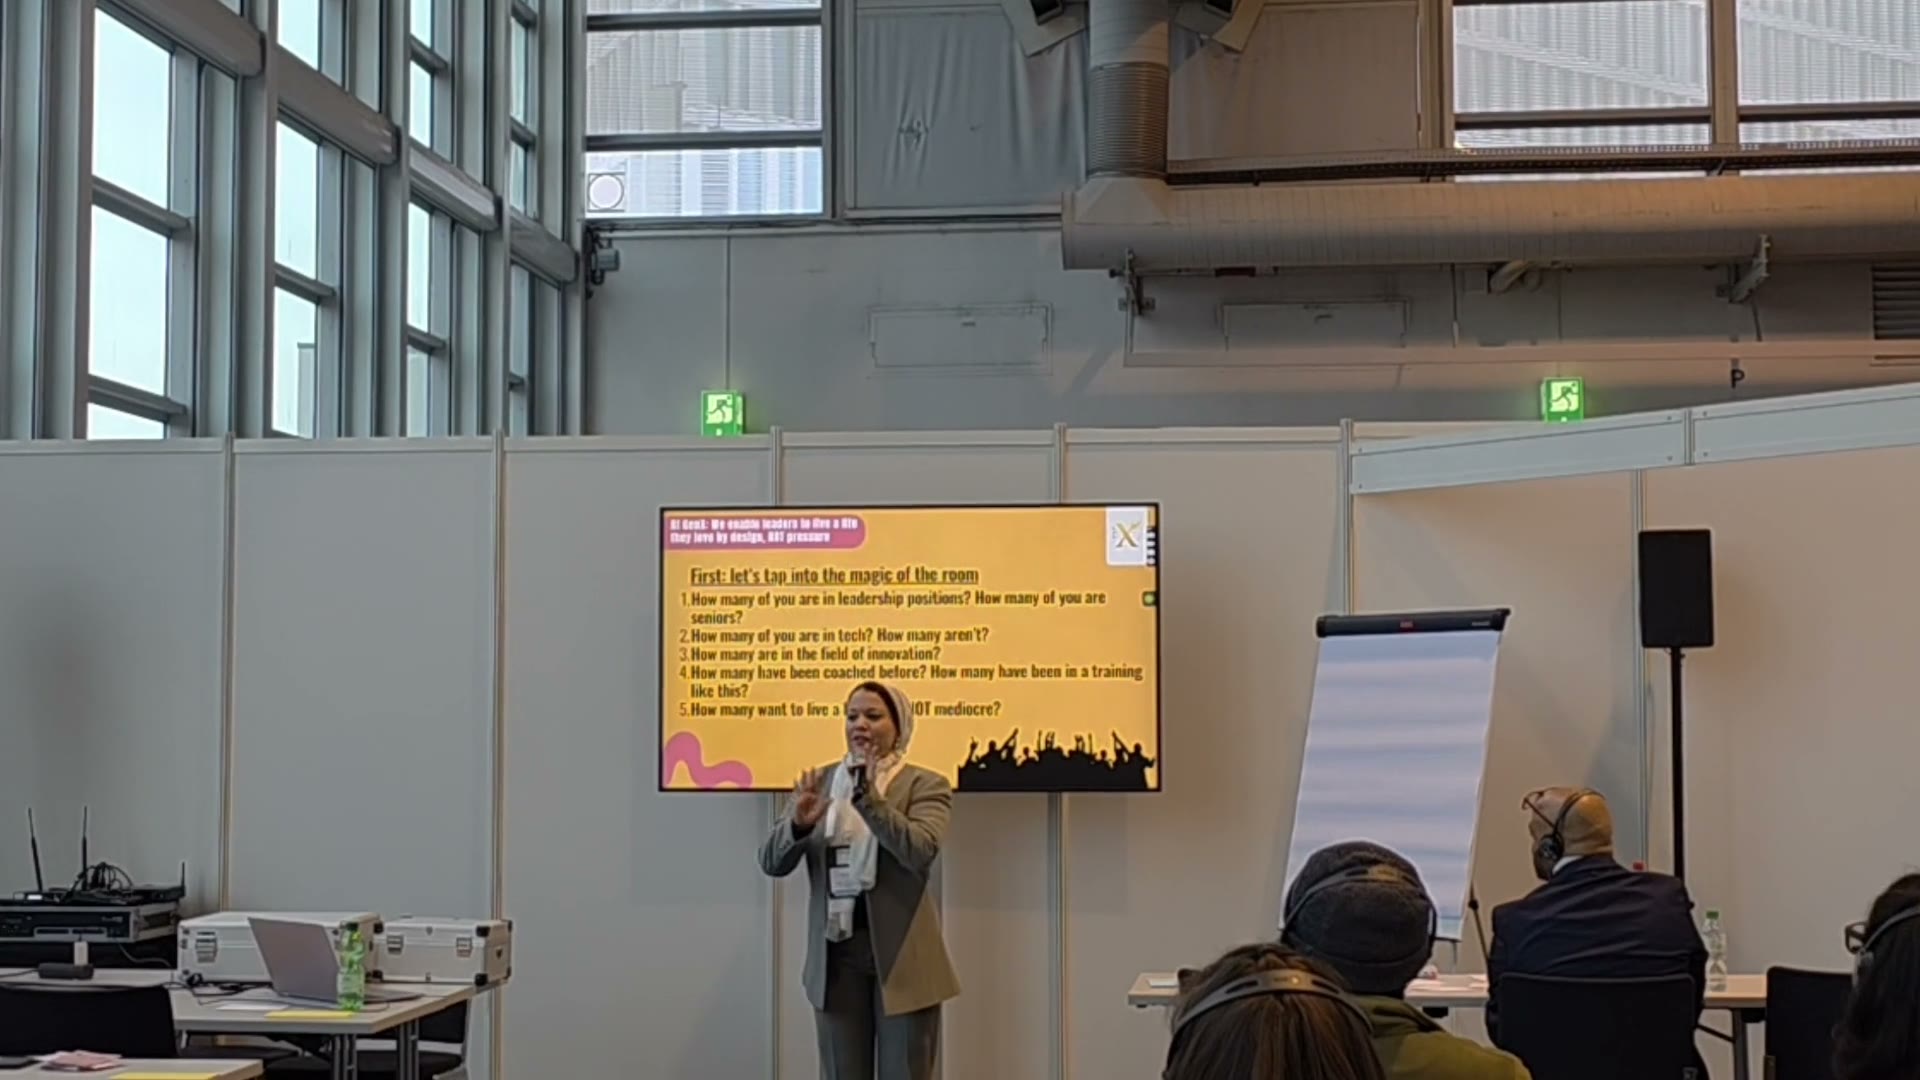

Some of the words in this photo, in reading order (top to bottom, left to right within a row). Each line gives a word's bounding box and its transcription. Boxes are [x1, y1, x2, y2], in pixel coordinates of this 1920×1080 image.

[711, 518, 725, 530] We
[727, 518, 760, 530] enable
[762, 518, 798, 530] leaders
[800, 517, 810, 529] to
[812, 517, 830, 529] live
[833, 519, 839, 529] a
[841, 517, 858, 529] life
[671, 532, 691, 544] they
[694, 531, 714, 543] love
[716, 531, 728, 544] by
[730, 531, 766, 544] design,
[786, 532, 830, 544] pressure
[691, 567, 726, 584] First:
[730, 567, 761, 583] let's
[764, 569, 787, 586] tap
[791, 567, 819, 583] into
[823, 567, 846, 582] the
[850, 567, 892, 586] magic
[897, 567, 911, 582] of
[915, 567, 937, 582] the
[942, 570, 979, 582] room
[720, 595, 754, 608] many
[758, 592, 771, 606] of
[773, 595, 795, 608] you
[799, 595, 820, 606] are
[823, 592, 835, 605] in
[838, 592, 904, 608] leadership
[907, 591, 971, 607] positions?
[975, 591, 1001, 605] How
[1004, 594, 1039, 607] many
[1043, 590, 1055, 604] of
[1059, 594, 1082, 606] you
[1085, 593, 1106, 604] are
[691, 610, 743, 625] seniors?
[720, 632, 754, 645] many
[758, 629, 771, 642] of
[773, 632, 795, 645] you
[799, 632, 820, 643] are
[823, 629, 835, 642] in
[838, 628, 873, 643] tech?
[877, 628, 904, 642] How
[907, 631, 941, 644] many
[944, 627, 990, 642] aren't?
[720, 651, 754, 664] many
[757, 650, 778, 661] are
[781, 648, 793, 661] in
[797, 648, 817, 661] the
[821, 647, 848, 660] field
[852, 647, 865, 660] of
[867, 646, 941, 661] innovation?
[720, 669, 754, 682] many
[757, 666, 787, 680] have
[790, 666, 820, 679] been
[823, 665, 875, 679] coached
[879, 664, 927, 679] before?
[931, 665, 957, 678] How
[960, 667, 994, 681] many
[998, 664, 1028, 678] have
[1031, 664, 1062, 678] been
[1065, 664, 1077, 677] in
[1081, 667, 1089, 677] a
[1092, 663, 1143, 681] training
[691, 684, 714, 698] like
[718, 683, 749, 698] this?
[720, 705, 754, 719] many
[757, 704, 787, 716] want
[790, 703, 803, 716] to
[807, 702, 829, 716] live
[832, 705, 839, 716] a
[934, 700, 1001, 717] mediocre?
